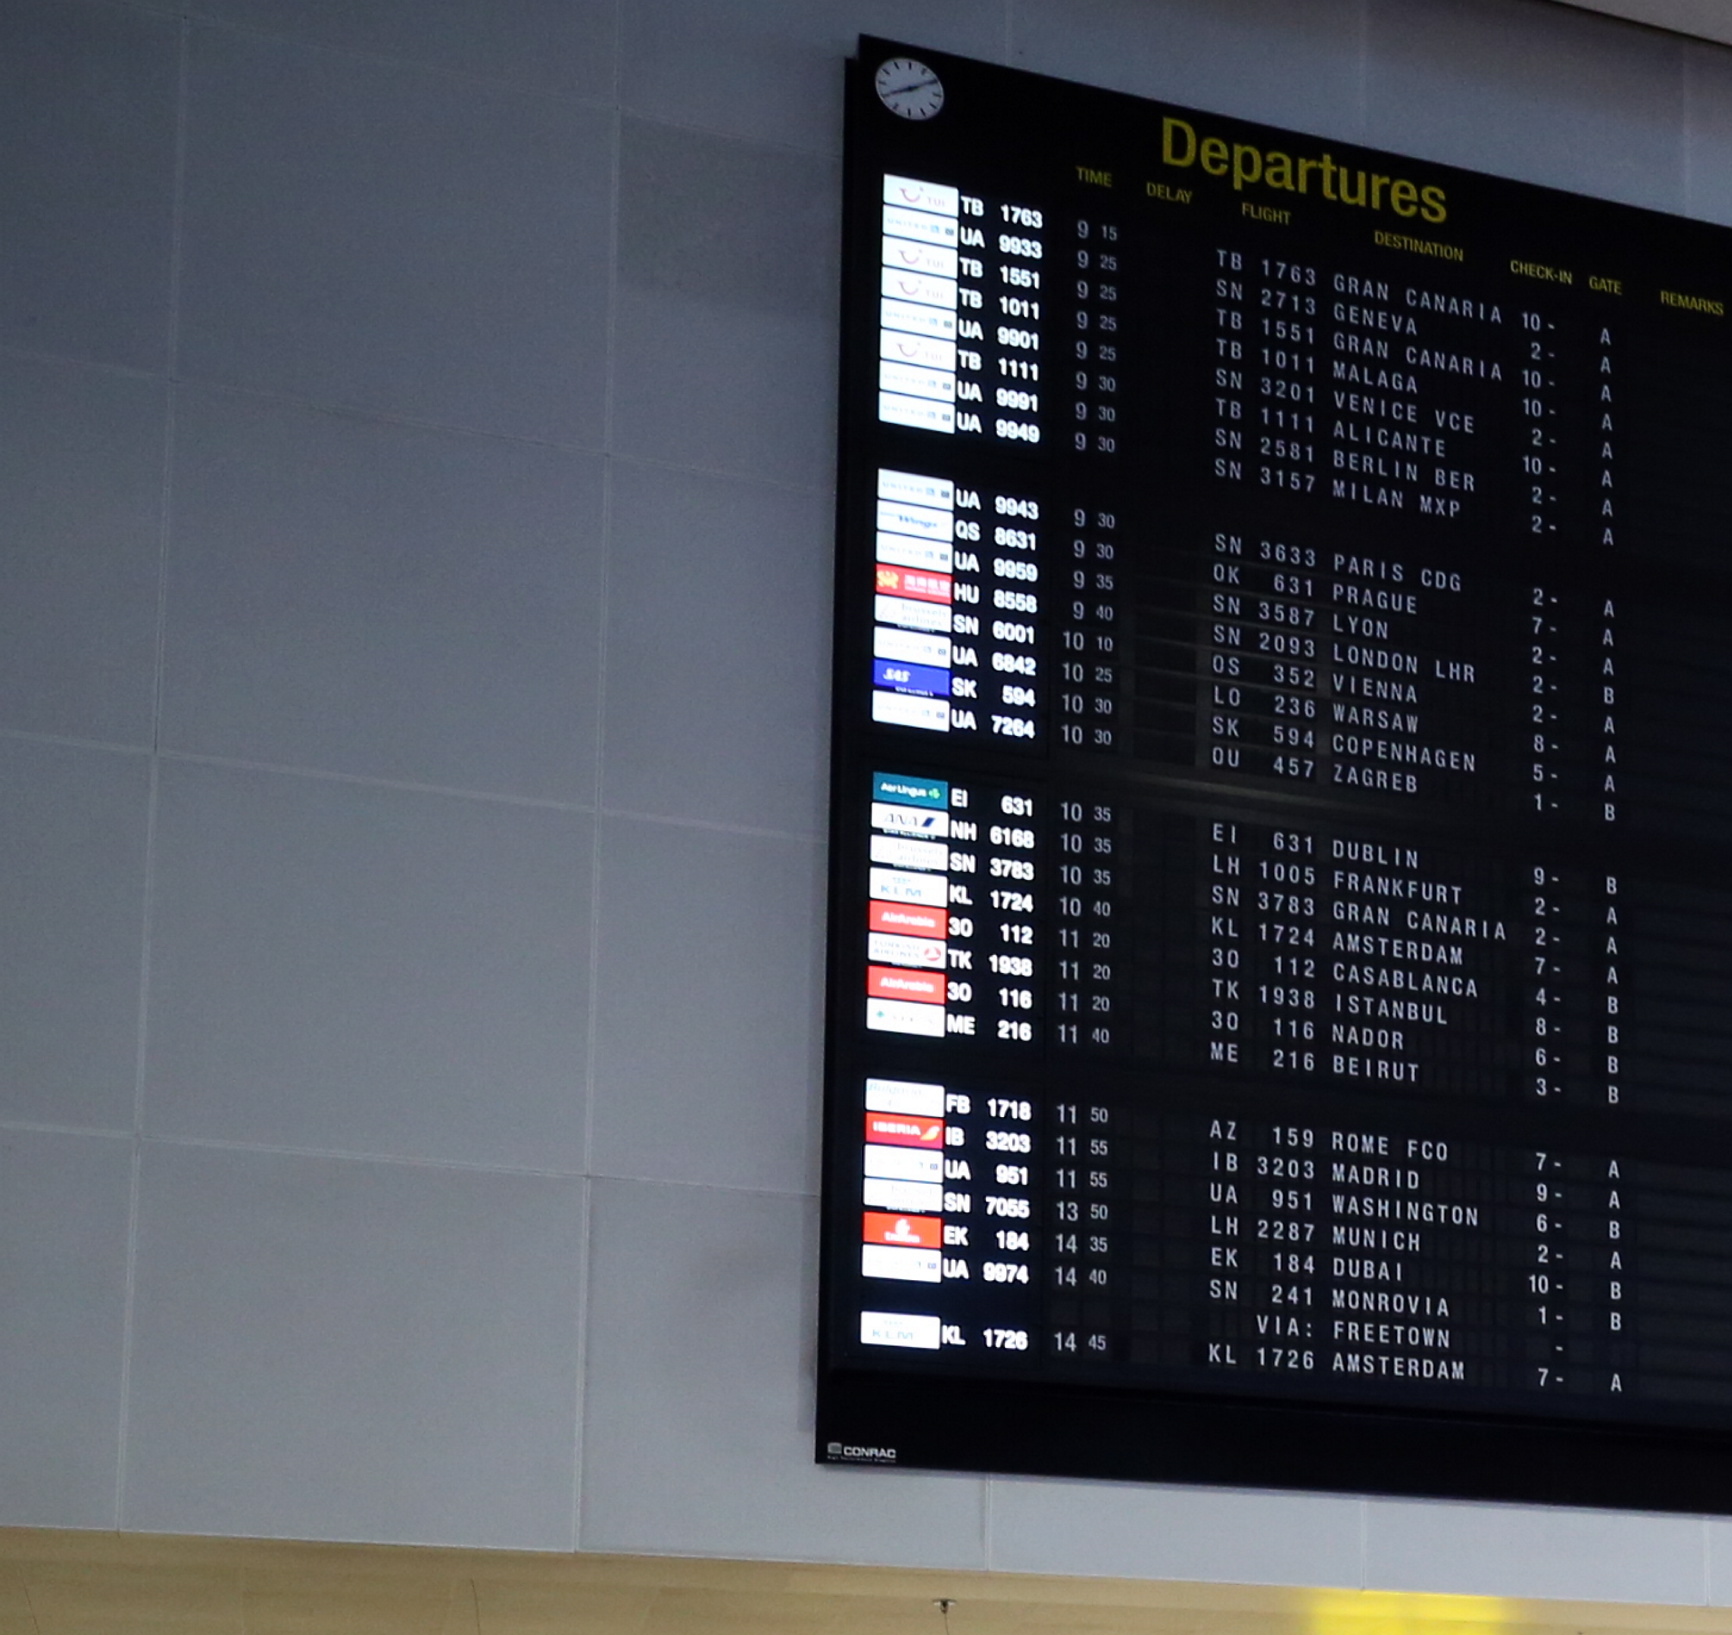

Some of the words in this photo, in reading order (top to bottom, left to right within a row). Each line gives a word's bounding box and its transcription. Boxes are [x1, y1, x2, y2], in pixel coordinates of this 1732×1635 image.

[1162, 116, 1447, 223] Departures
[1076, 166, 1112, 188] TIME
[1146, 182, 1193, 204] DELAY
[1242, 202, 1291, 225] FLIGHT
[1374, 229, 1463, 262] DESTINATION
[1510, 259, 1572, 285] CHECK-IN
[1589, 275, 1622, 296] GATE
[1660, 290, 1724, 316] REMARKS
[1333, 273, 1389, 301] GRAN
[1406, 288, 1502, 324] CANARIA
[1334, 303, 1417, 336] GENEVA
[1333, 360, 1417, 394] MALAGA
[1334, 390, 1417, 423] VENICE
[1435, 410, 1474, 434] VCE
[1333, 420, 1445, 458] ALICANTE
[1333, 449, 1418, 482] BERLIN
[1435, 468, 1475, 492] BER
[1333, 479, 1403, 508] MILAN
[1419, 494, 1460, 518] MXP
[1334, 553, 1404, 582] PARIS
[1420, 568, 1461, 592] CDG
[1333, 583, 1417, 614] PRAGUE
[1333, 613, 1388, 639] LYON
[1334, 643, 1418, 674] LONDON
[1436, 659, 1475, 683] LHR
[1333, 673, 1417, 704] VIENNA
[1333, 703, 1419, 733] WARSAW
[1333, 734, 1475, 772] COPENHAGEN
[1334, 764, 1417, 793] ZAGREB
[1333, 839, 1418, 869] DUBLIN
[1334, 870, 1462, 905] FRANKFURT
[1332, 931, 1463, 965] AMSTERDAM
[1333, 962, 1478, 998] CASABLANCA
[1336, 993, 1448, 1025] ISTANBUL
[1332, 1023, 1403, 1050] NADOR
[1333, 1054, 1419, 1083] BEIRUT
[873, 1121, 921, 1137] IBERIA
[1331, 1131, 1389, 1156] ROME
[1408, 1139, 1448, 1162] FCO
[1332, 1162, 1419, 1190] MADRID
[1332, 1194, 1478, 1227] WASHINGTON
[1332, 1225, 1420, 1252] MUNICH
[1333, 1257, 1402, 1282] DUBAI
[1332, 1288, 1449, 1317] MONROVIA
[1334, 1320, 1449, 1349] FREETOWN
[1332, 1352, 1464, 1381] AMSTERDAM
[843, 1446, 896, 1459] CONRAC
